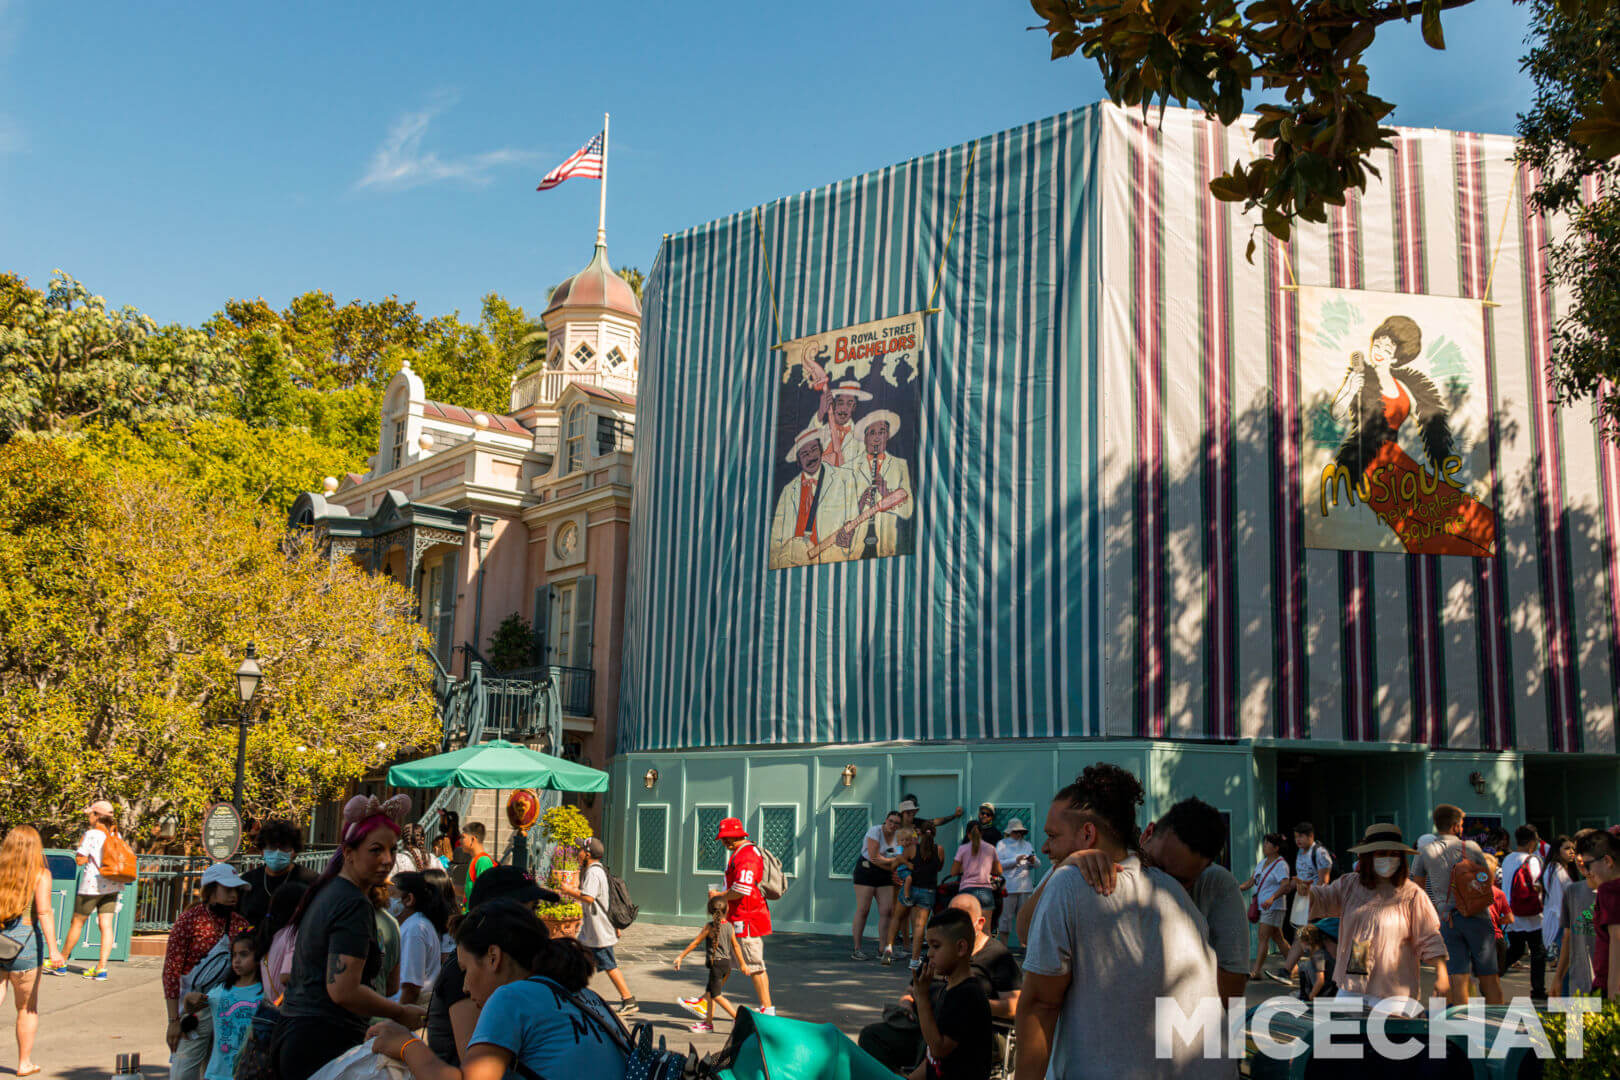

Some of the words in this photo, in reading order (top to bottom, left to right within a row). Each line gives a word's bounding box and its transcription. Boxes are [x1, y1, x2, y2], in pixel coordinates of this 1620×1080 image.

[851, 331, 878, 345] ROYAL
[882, 322, 916, 338] STREET
[834, 334, 916, 364] BACHELORS
[739, 869, 754, 885] 16
